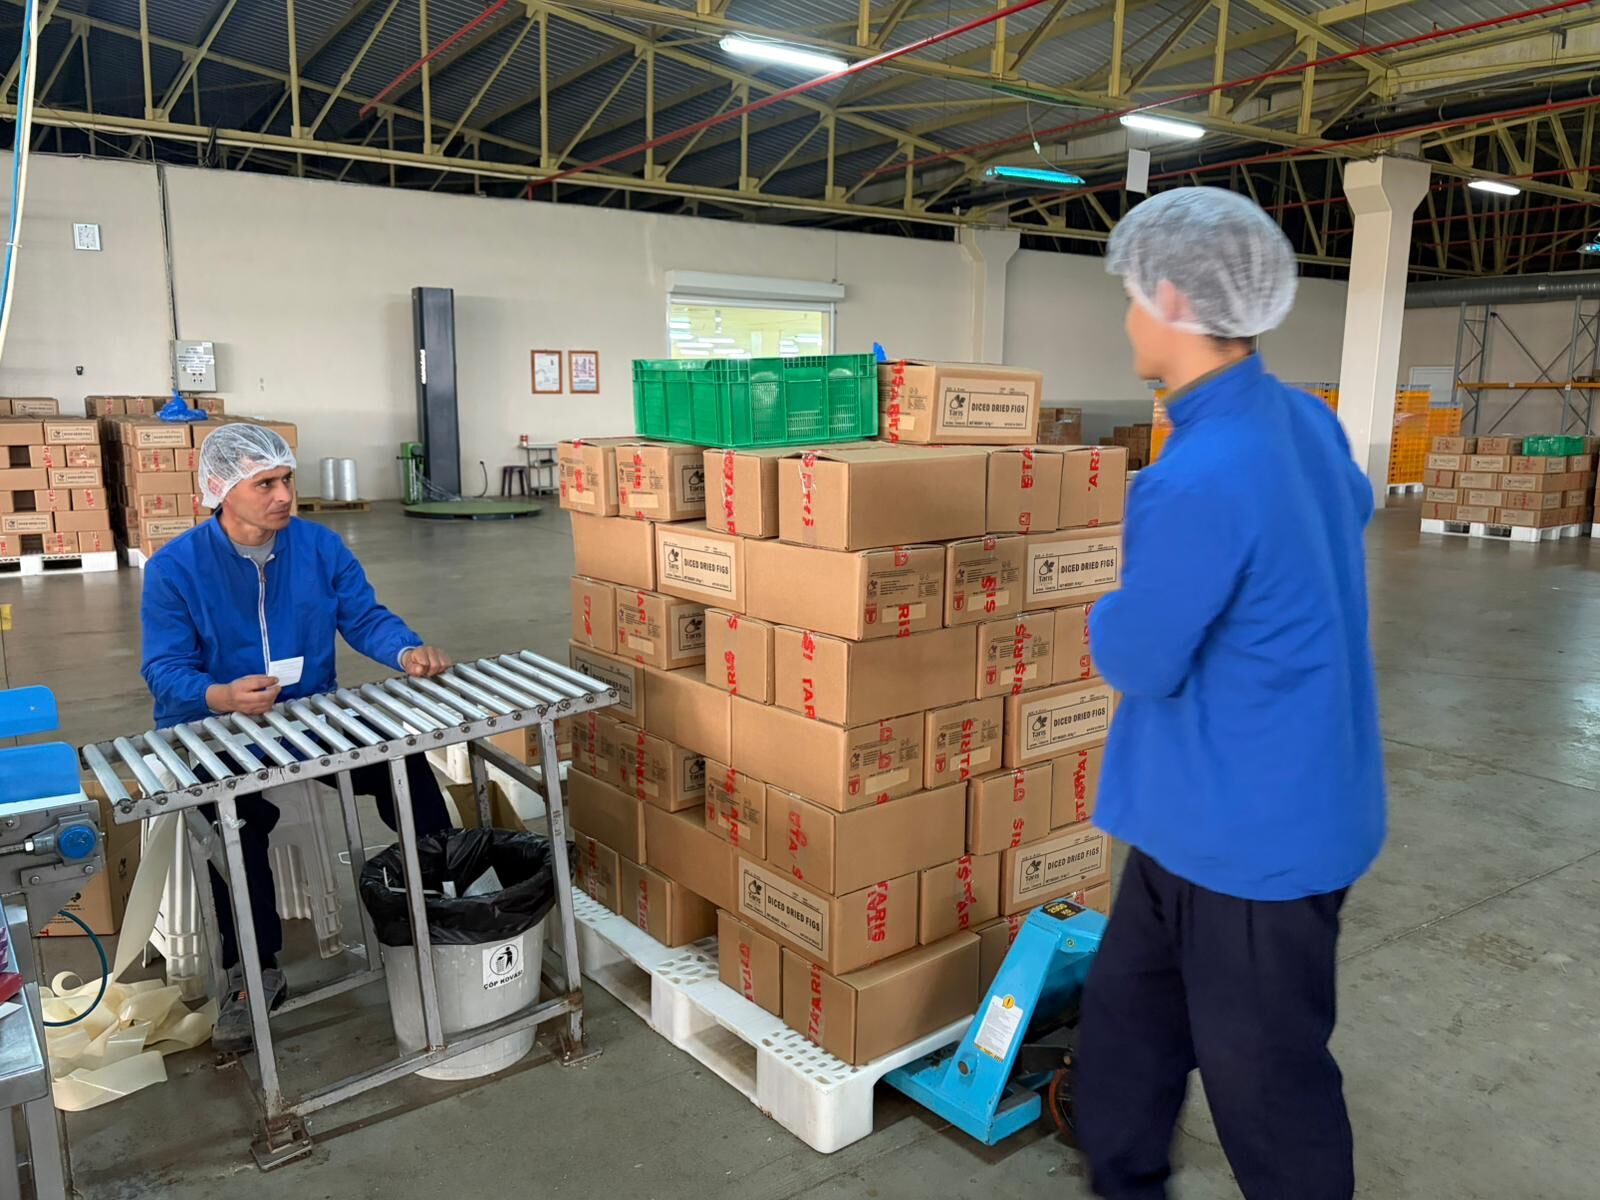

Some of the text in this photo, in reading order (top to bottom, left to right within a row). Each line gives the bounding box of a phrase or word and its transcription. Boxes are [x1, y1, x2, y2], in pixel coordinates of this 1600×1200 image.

[971, 402, 1024, 414] DICED DRIED FIGS
[684, 558, 729, 575] DICED DRIED FIGS
[1060, 558, 1114, 574] DICED DRIED FIGS
[1054, 707, 1106, 727] DICED DRIED FIGS
[1048, 846, 1100, 870] DICED DRIED FIGS
[767, 895, 785, 912] DICED
[786, 906, 805, 923] DRIED
[805, 916, 820, 932] FIGS
